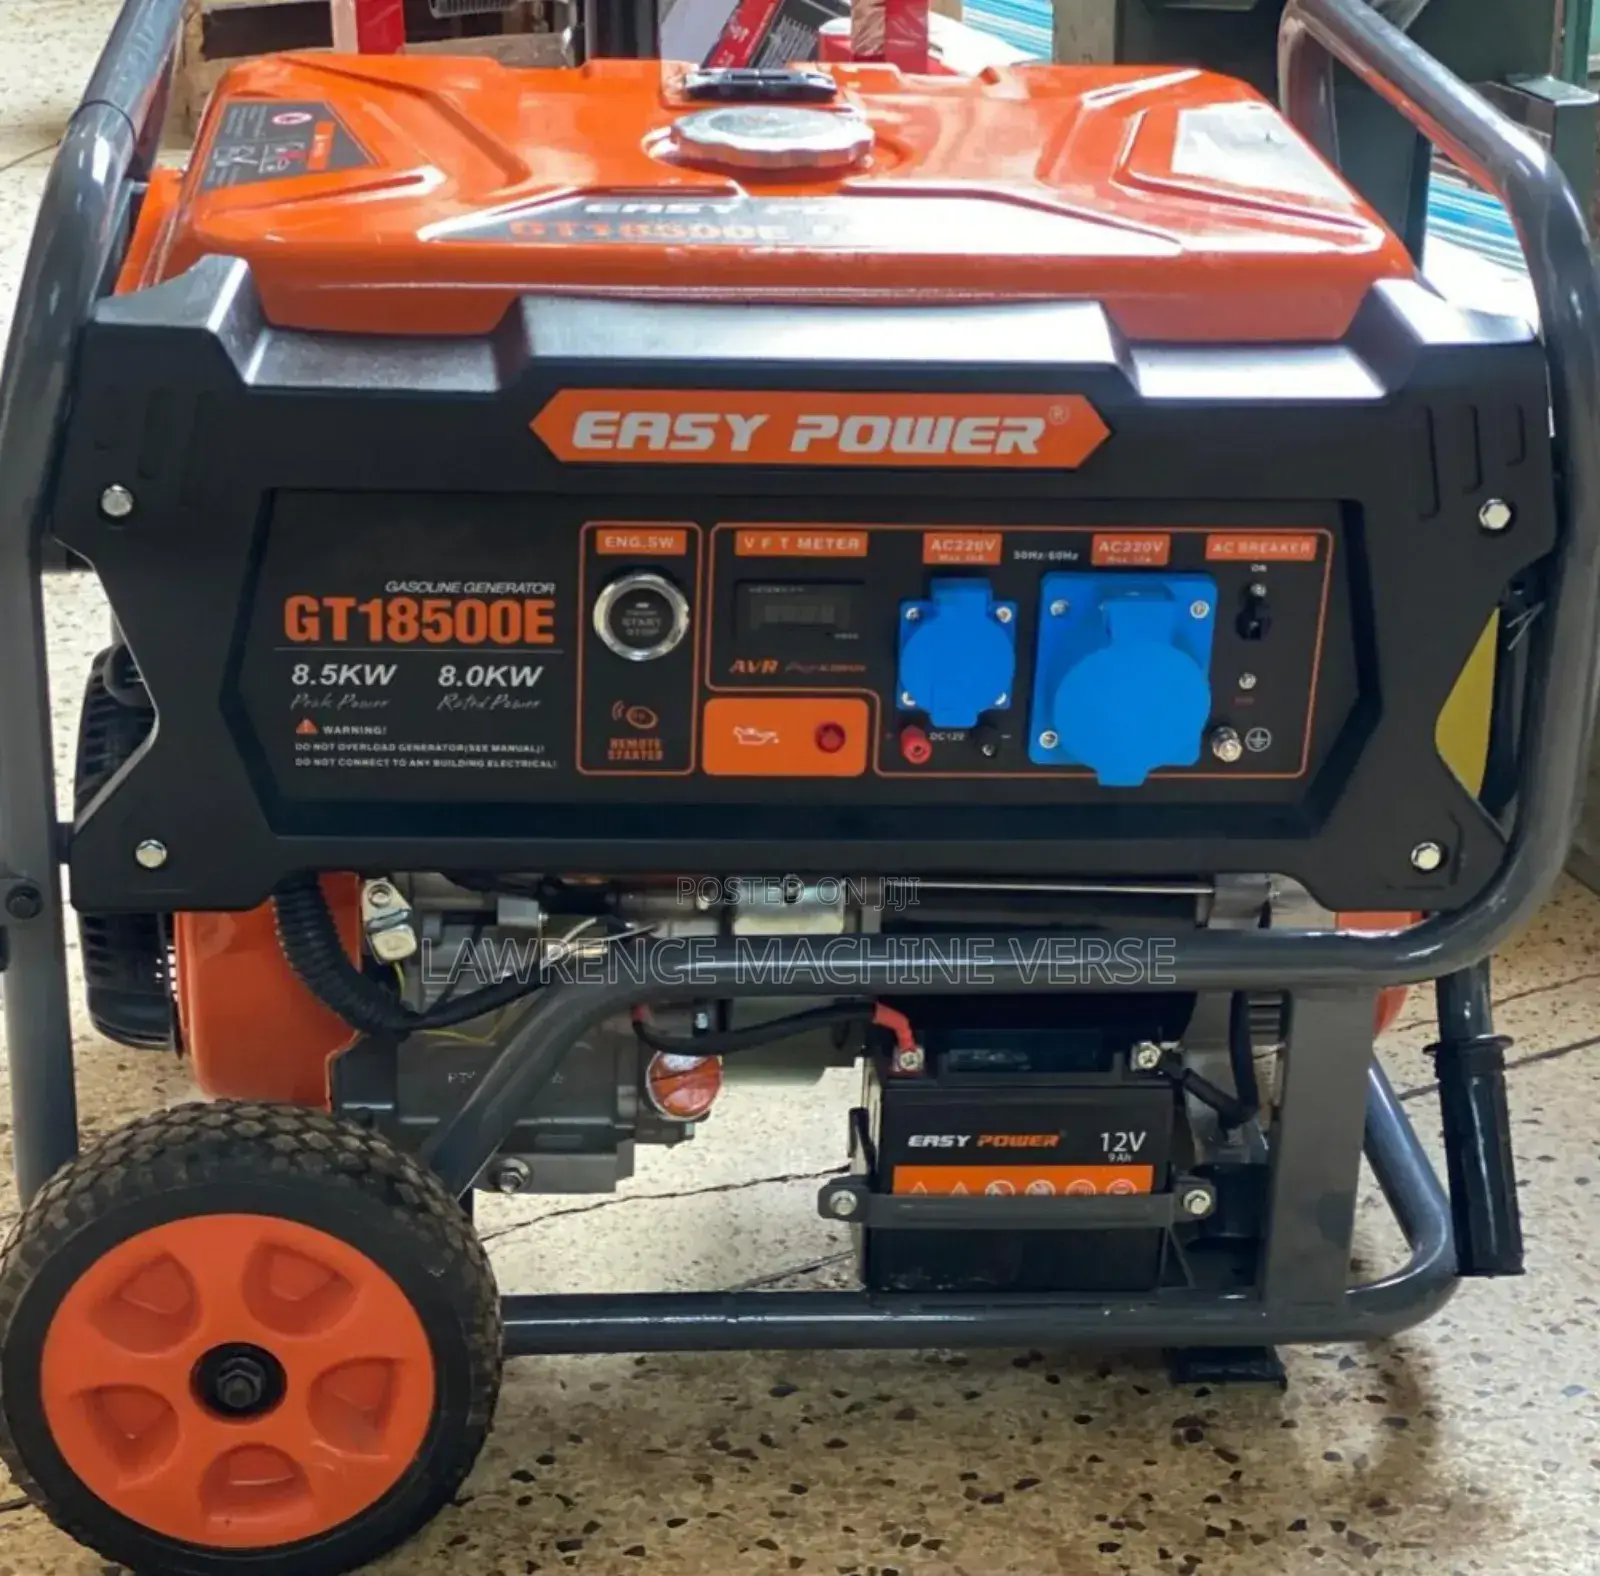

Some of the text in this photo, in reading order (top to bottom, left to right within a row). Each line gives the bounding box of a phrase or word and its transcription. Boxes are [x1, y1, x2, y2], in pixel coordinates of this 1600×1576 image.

[572, 411, 1046, 455] EASY POWER
[604, 535, 674, 549] ENG.SW
[797, 537, 860, 550] METER
[931, 539, 996, 552] AC220V
[1099, 540, 1164, 553] AC220V
[1212, 541, 1311, 554] AC BREAKER
[385, 580, 556, 595] GASOLINE GENERATOR
[284, 594, 556, 644] GT18500E
[728, 658, 779, 673] AVR
[291, 663, 544, 687] 8.5KW 8.0KW
[323, 725, 387, 735] WARNING!
[295, 742, 312, 752] DO
[313, 742, 335, 752] NOT
[338, 742, 396, 752] OVERLOAD
[295, 758, 312, 767] DO
[313, 758, 335, 767] NOT
[338, 758, 389, 768] CONNECT
[392, 758, 407, 768] TO
[907, 1134, 1060, 1148] EASY POWER
[1100, 1131, 1147, 1152] 12V
